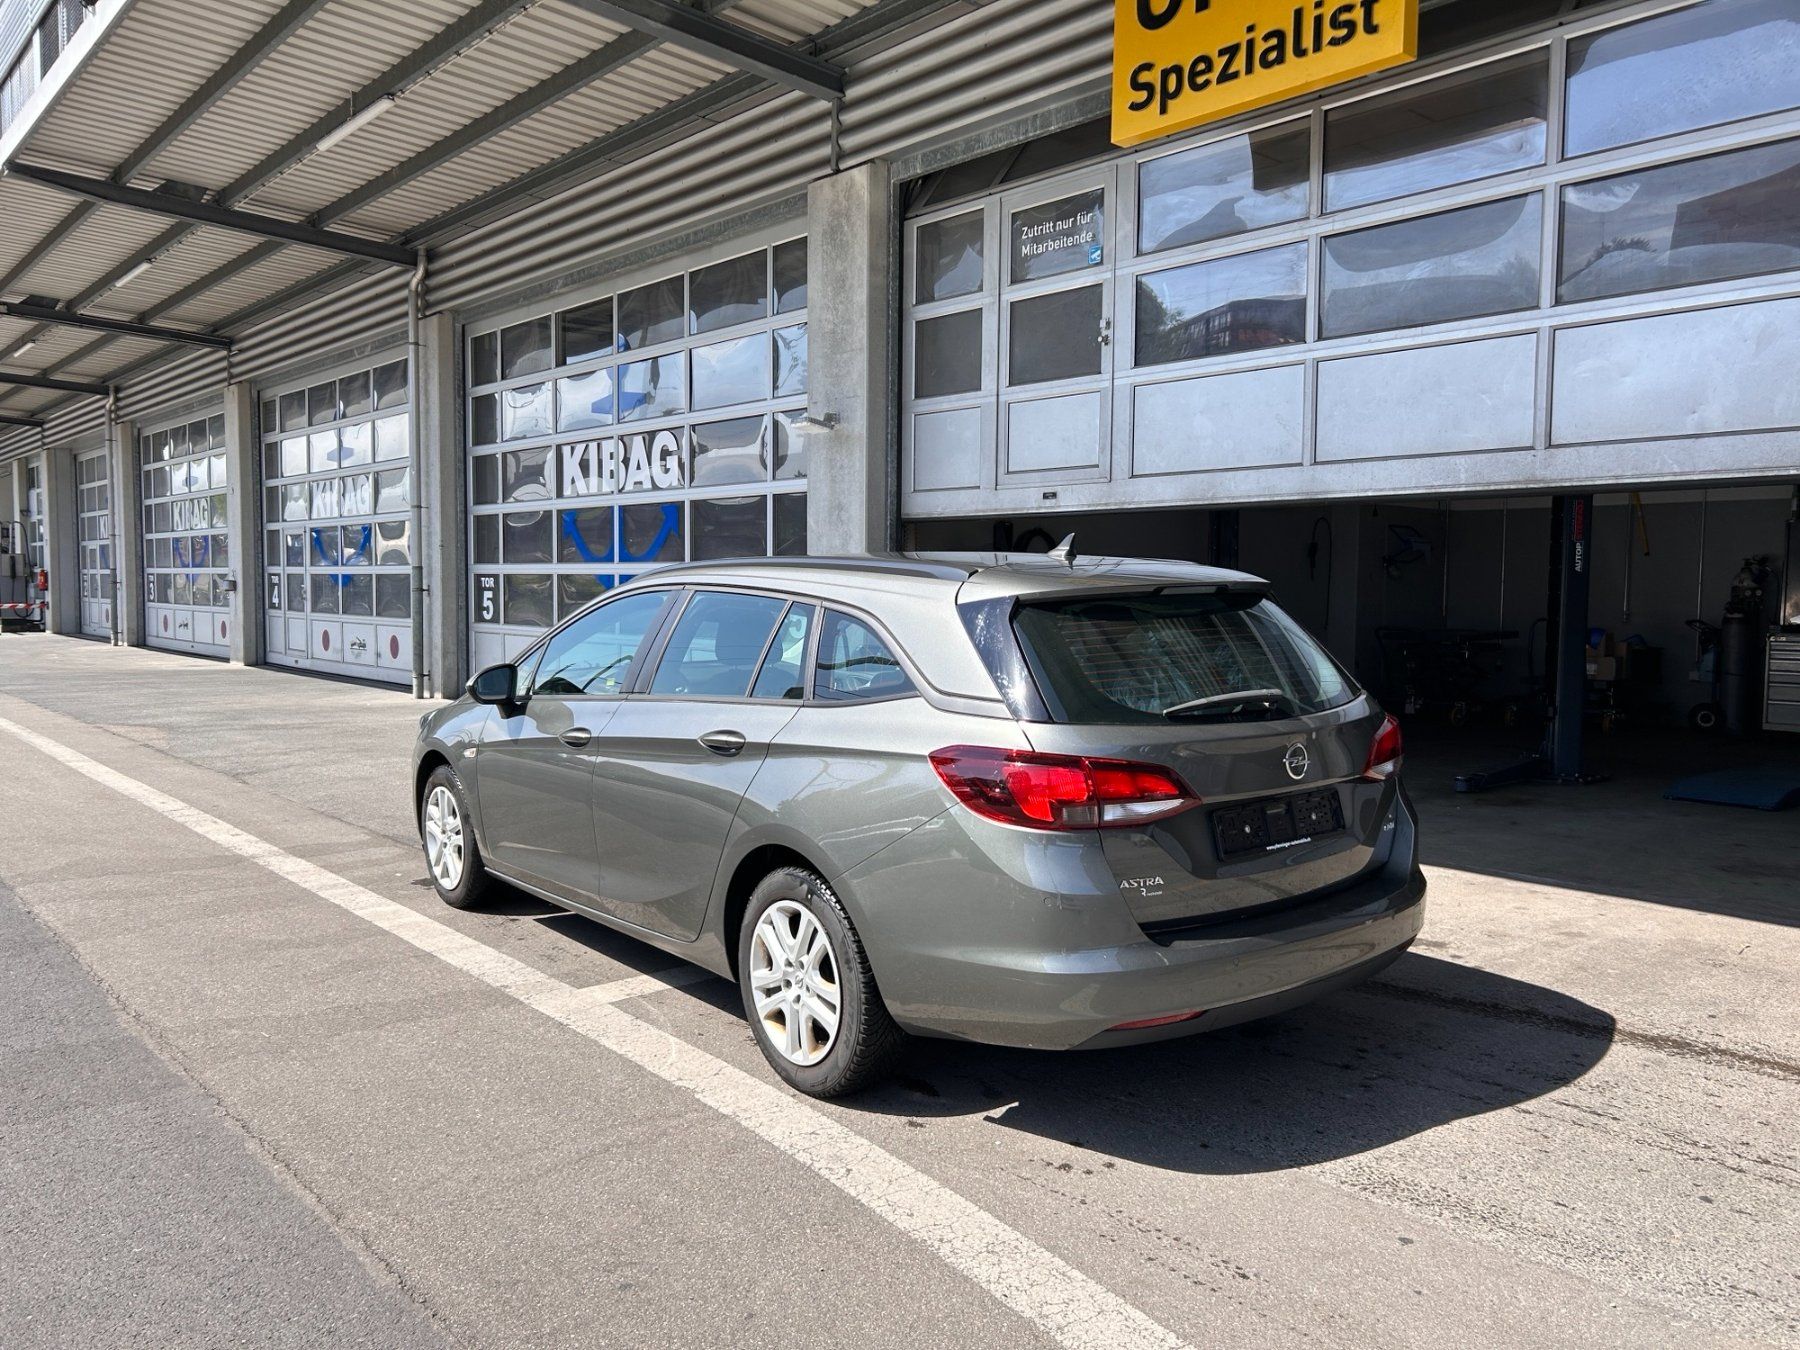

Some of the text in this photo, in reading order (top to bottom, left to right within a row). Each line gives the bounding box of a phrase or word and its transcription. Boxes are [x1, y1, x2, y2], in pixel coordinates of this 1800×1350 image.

[1128, 0, 1379, 115] Spezialist
[1021, 211, 1093, 240] Zutritt nur für
[1021, 230, 1093, 257] Mitarbeitende
[561, 430, 679, 496] KIBAG
[149, 582, 155, 600] 3
[272, 585, 280, 607] 4
[480, 577, 494, 588] TOR
[482, 590, 494, 620] 5
[1120, 876, 1164, 889] ASTRA
